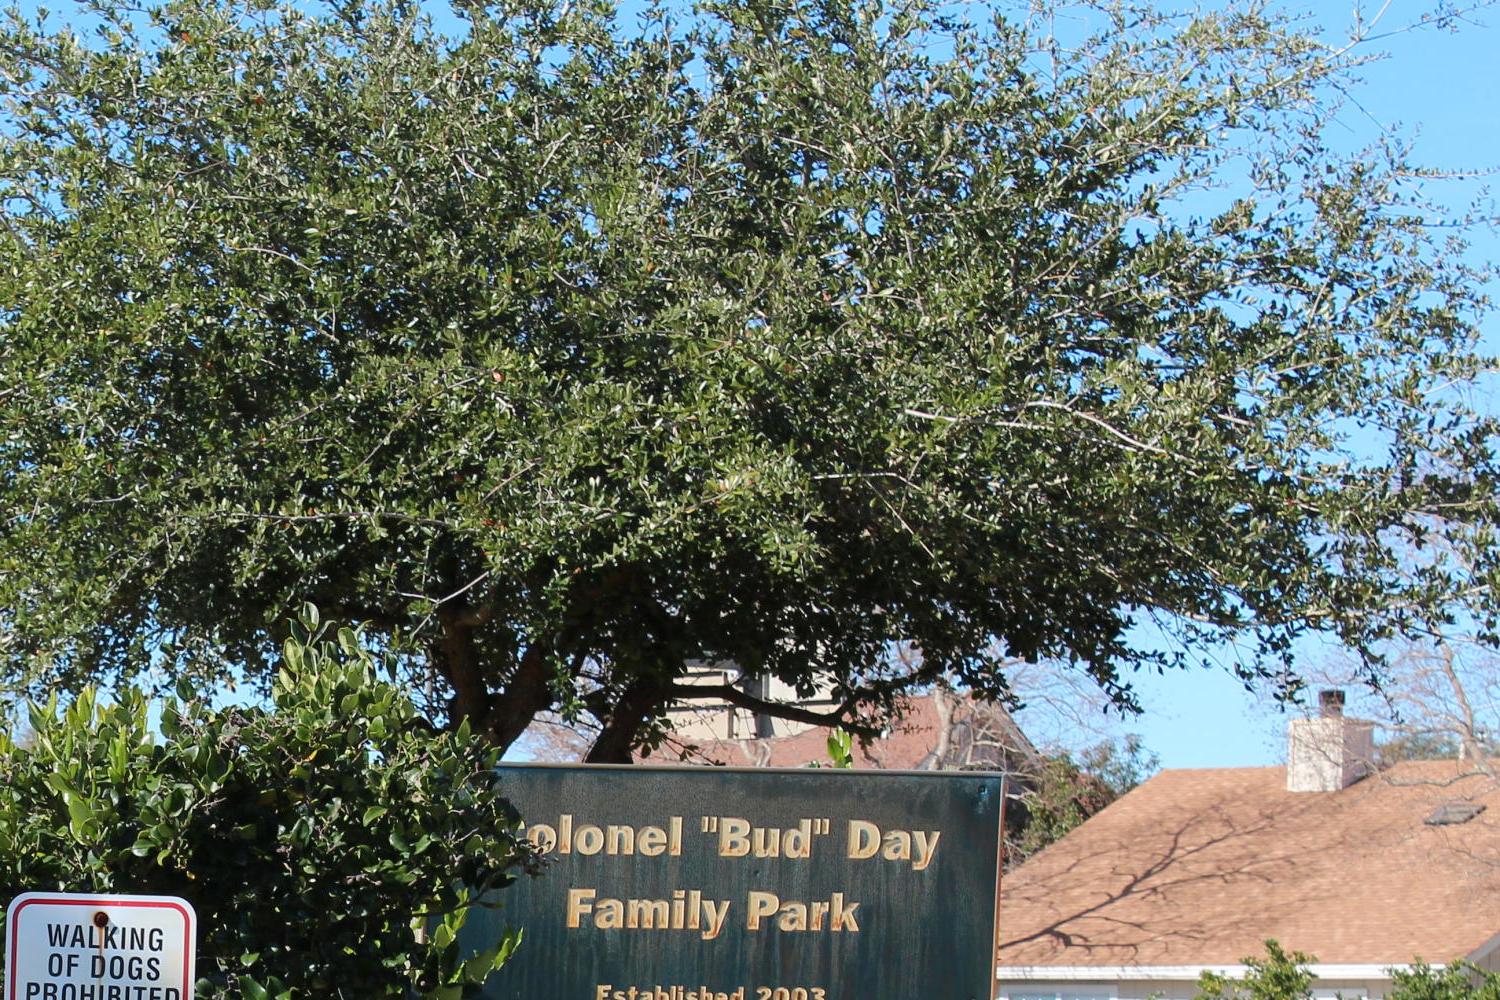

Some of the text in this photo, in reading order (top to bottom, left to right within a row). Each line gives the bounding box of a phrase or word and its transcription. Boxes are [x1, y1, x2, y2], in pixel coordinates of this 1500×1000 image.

[515, 814, 940, 870] olonel "Bud" Day
[566, 888, 860, 940] Family Park
[48, 924, 164, 951] WALKING
[48, 953, 160, 981] OF DOGS
